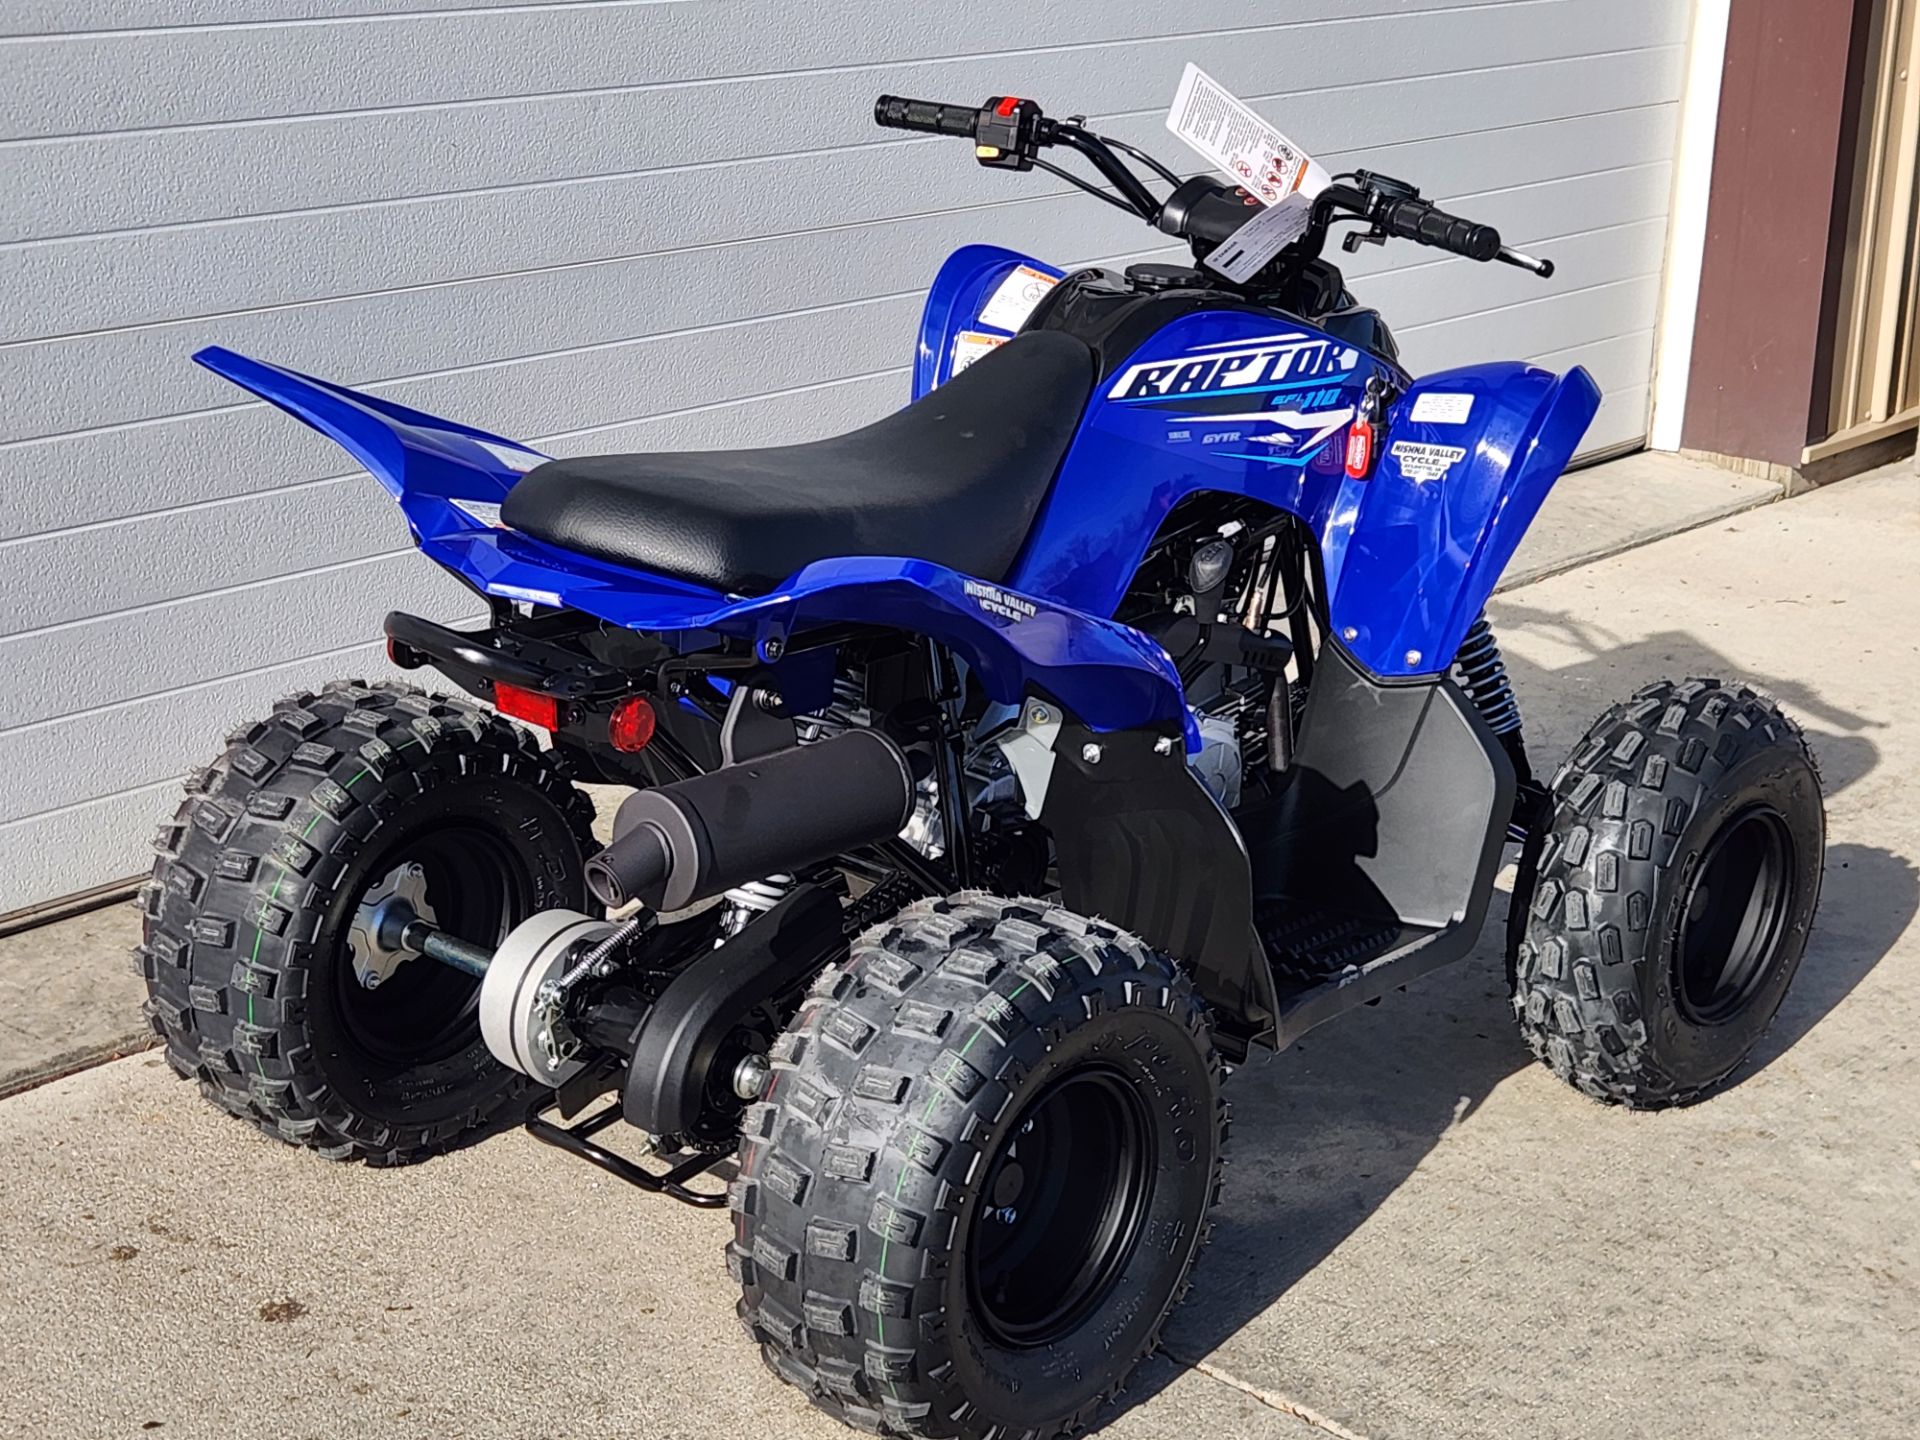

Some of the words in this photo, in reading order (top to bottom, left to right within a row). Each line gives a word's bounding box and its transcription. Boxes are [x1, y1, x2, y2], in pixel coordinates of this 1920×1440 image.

[1123, 345, 1345, 398] RAPTOR
[1201, 431, 1242, 445] GYTR
[1394, 444, 1426, 456] NISHNA
[1428, 447, 1463, 460] VALLEY
[1402, 455, 1440, 466] CYCLE
[964, 580, 1002, 603] NISHNA
[1003, 594, 1036, 617] VALLEY
[982, 600, 1021, 622] CYCLE
